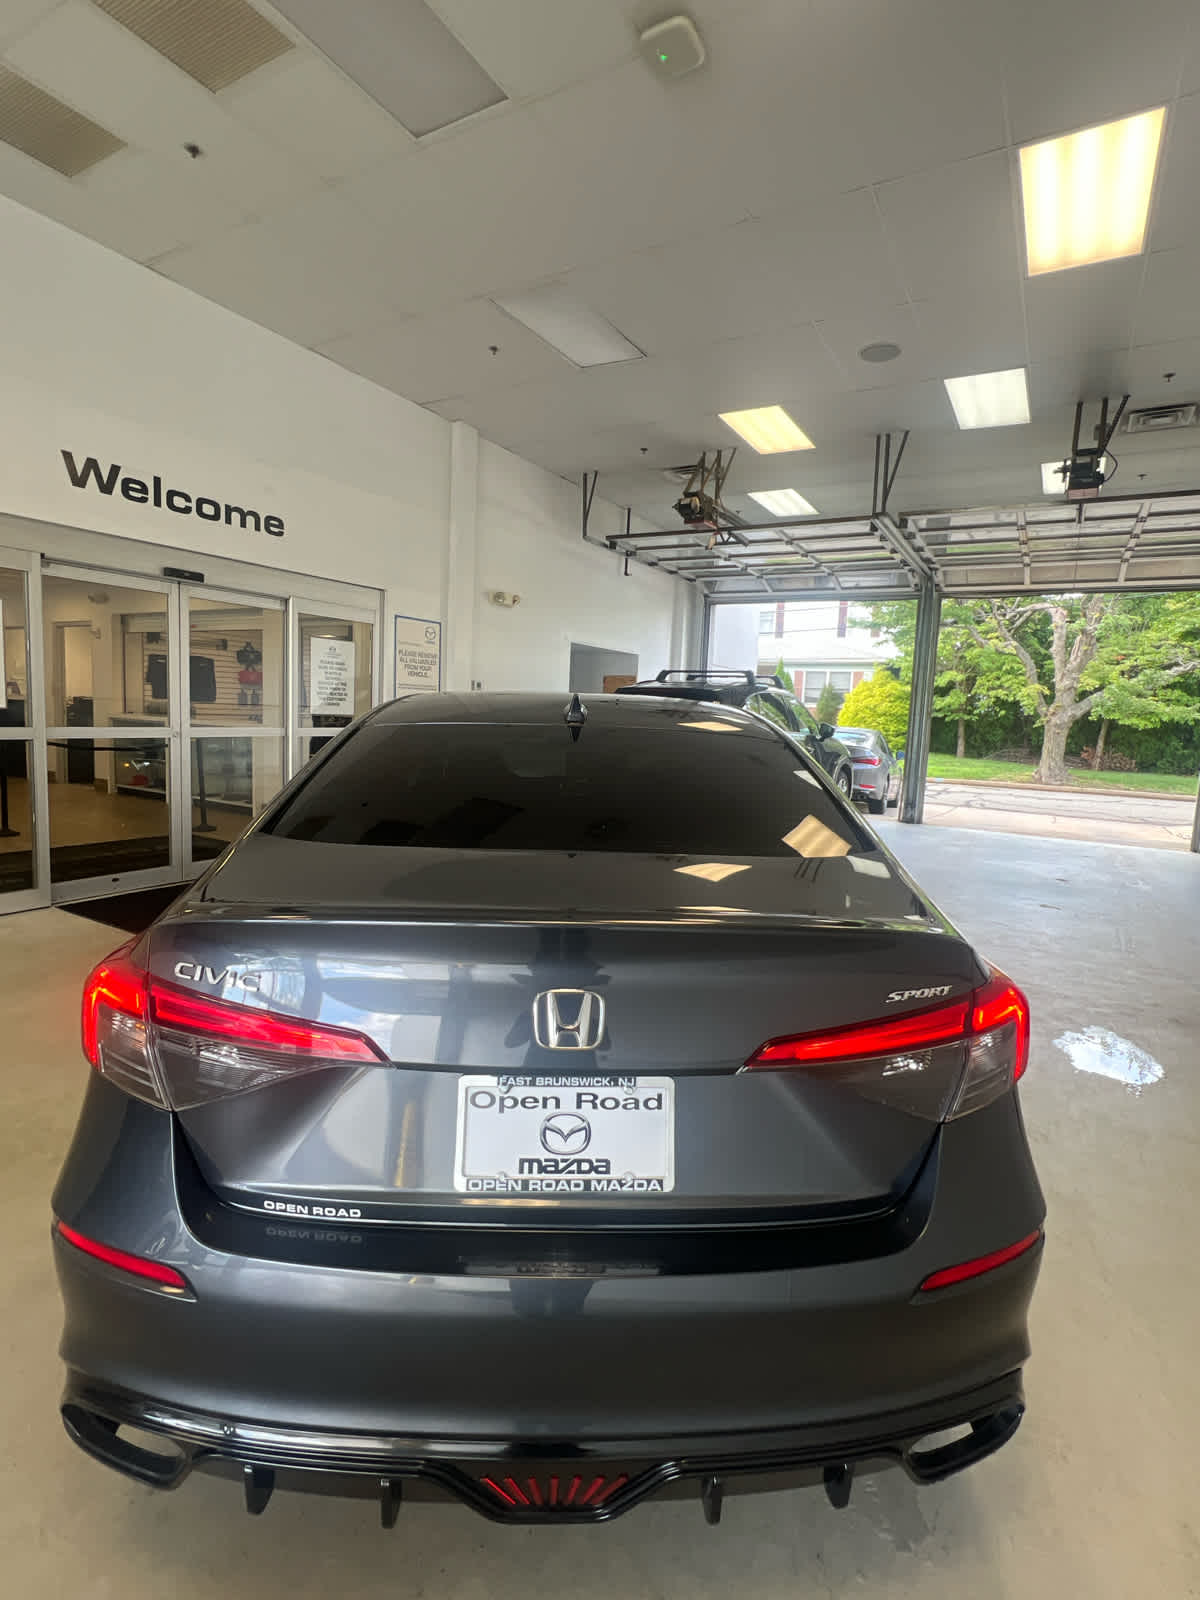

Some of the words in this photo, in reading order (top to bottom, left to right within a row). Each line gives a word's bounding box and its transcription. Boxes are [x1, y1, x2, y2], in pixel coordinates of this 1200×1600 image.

[60, 449, 285, 537] Welcome
[398, 648, 417, 658] PLEASE
[400, 656, 408, 664] ALL
[404, 663, 418, 671] FROM
[174, 962, 261, 992] CIVIC
[885, 984, 953, 1003] SPORT
[535, 1076, 614, 1087] BRUNSWICK,
[618, 1076, 635, 1087] NJ
[469, 1090, 561, 1114] Open
[575, 1091, 663, 1110] Road
[468, 1179, 522, 1192] OPEN
[528, 1179, 585, 1192] ROAD
[590, 1179, 662, 1192] MAZDA
[263, 1200, 309, 1214] OPEN
[312, 1206, 362, 1218] ROAD
